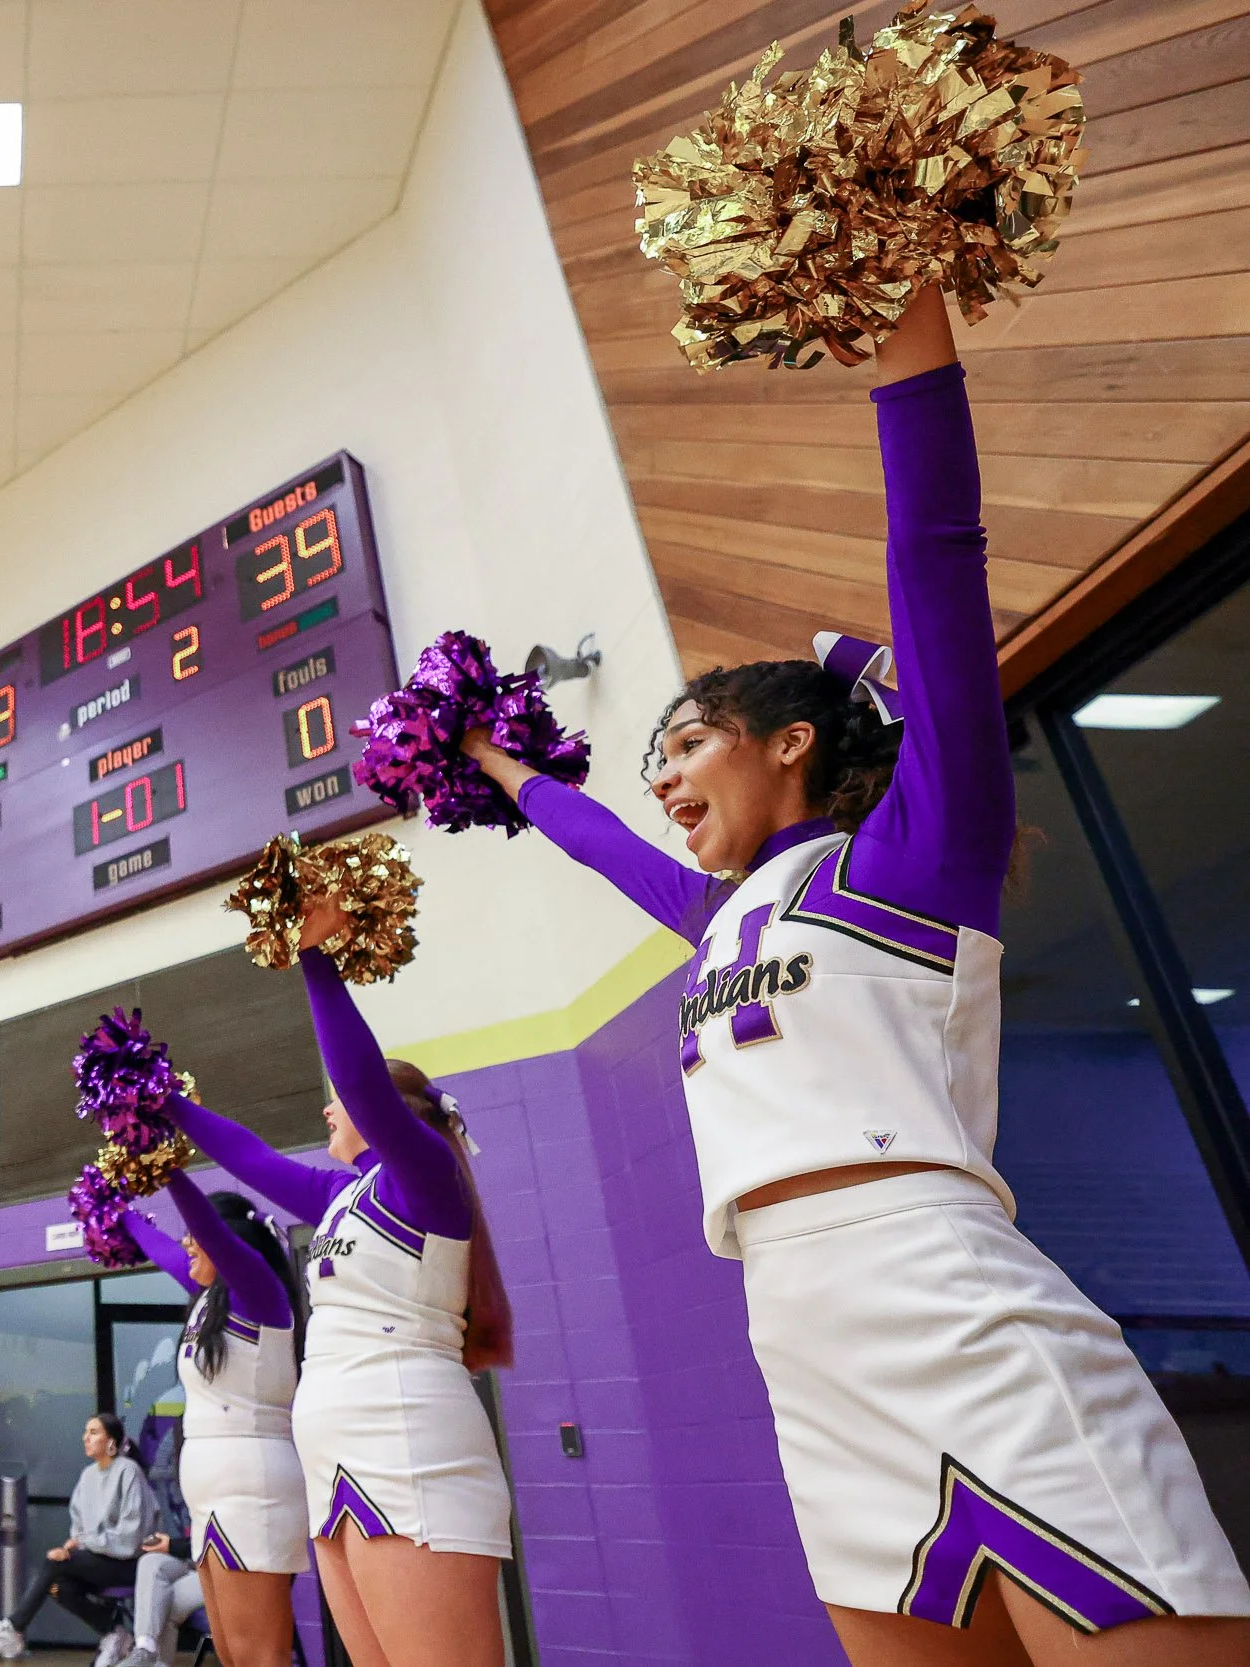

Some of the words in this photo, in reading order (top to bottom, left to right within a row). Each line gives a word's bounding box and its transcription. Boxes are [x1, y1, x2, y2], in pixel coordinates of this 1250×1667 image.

[249, 481, 318, 532] Guests
[254, 508, 342, 611] 39
[62, 545, 202, 669] 18:54
[172, 625, 199, 680] 2
[278, 657, 328, 693] fouls
[77, 678, 130, 728] period
[298, 696, 334, 759] 0
[97, 736, 152, 780] player
[295, 775, 339, 807] won
[107, 850, 153, 886] game
